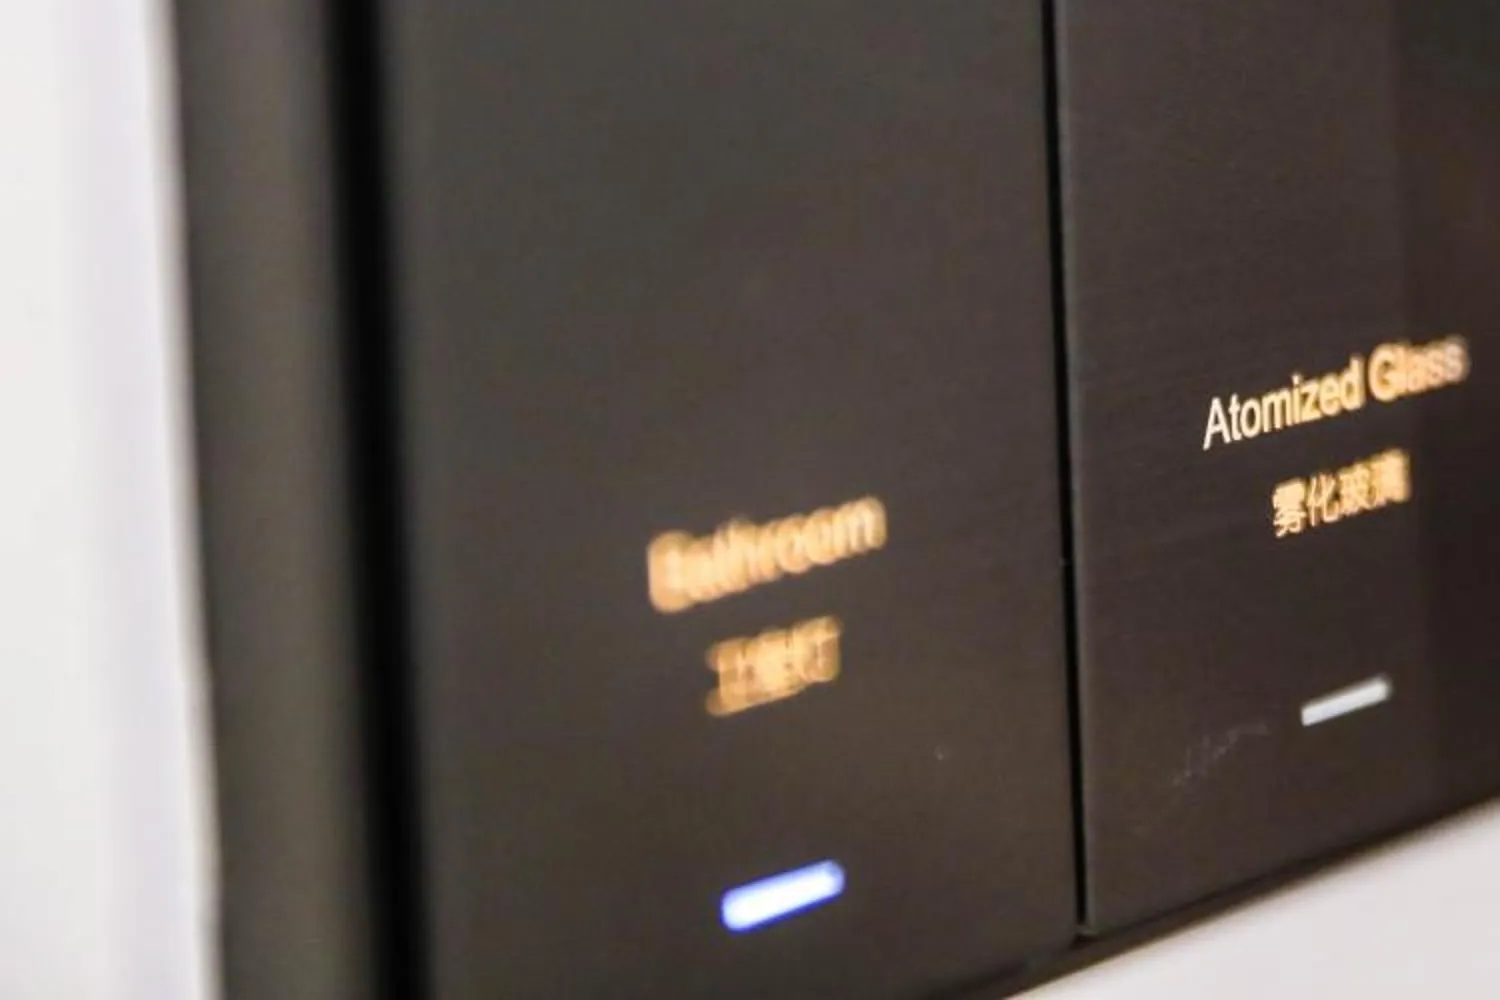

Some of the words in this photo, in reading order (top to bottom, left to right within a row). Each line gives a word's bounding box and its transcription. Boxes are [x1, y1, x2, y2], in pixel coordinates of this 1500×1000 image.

[1202, 354, 1366, 450] Atomized
[1368, 337, 1468, 402] Glass
[1271, 449, 1410, 538] 雾化玻璃
